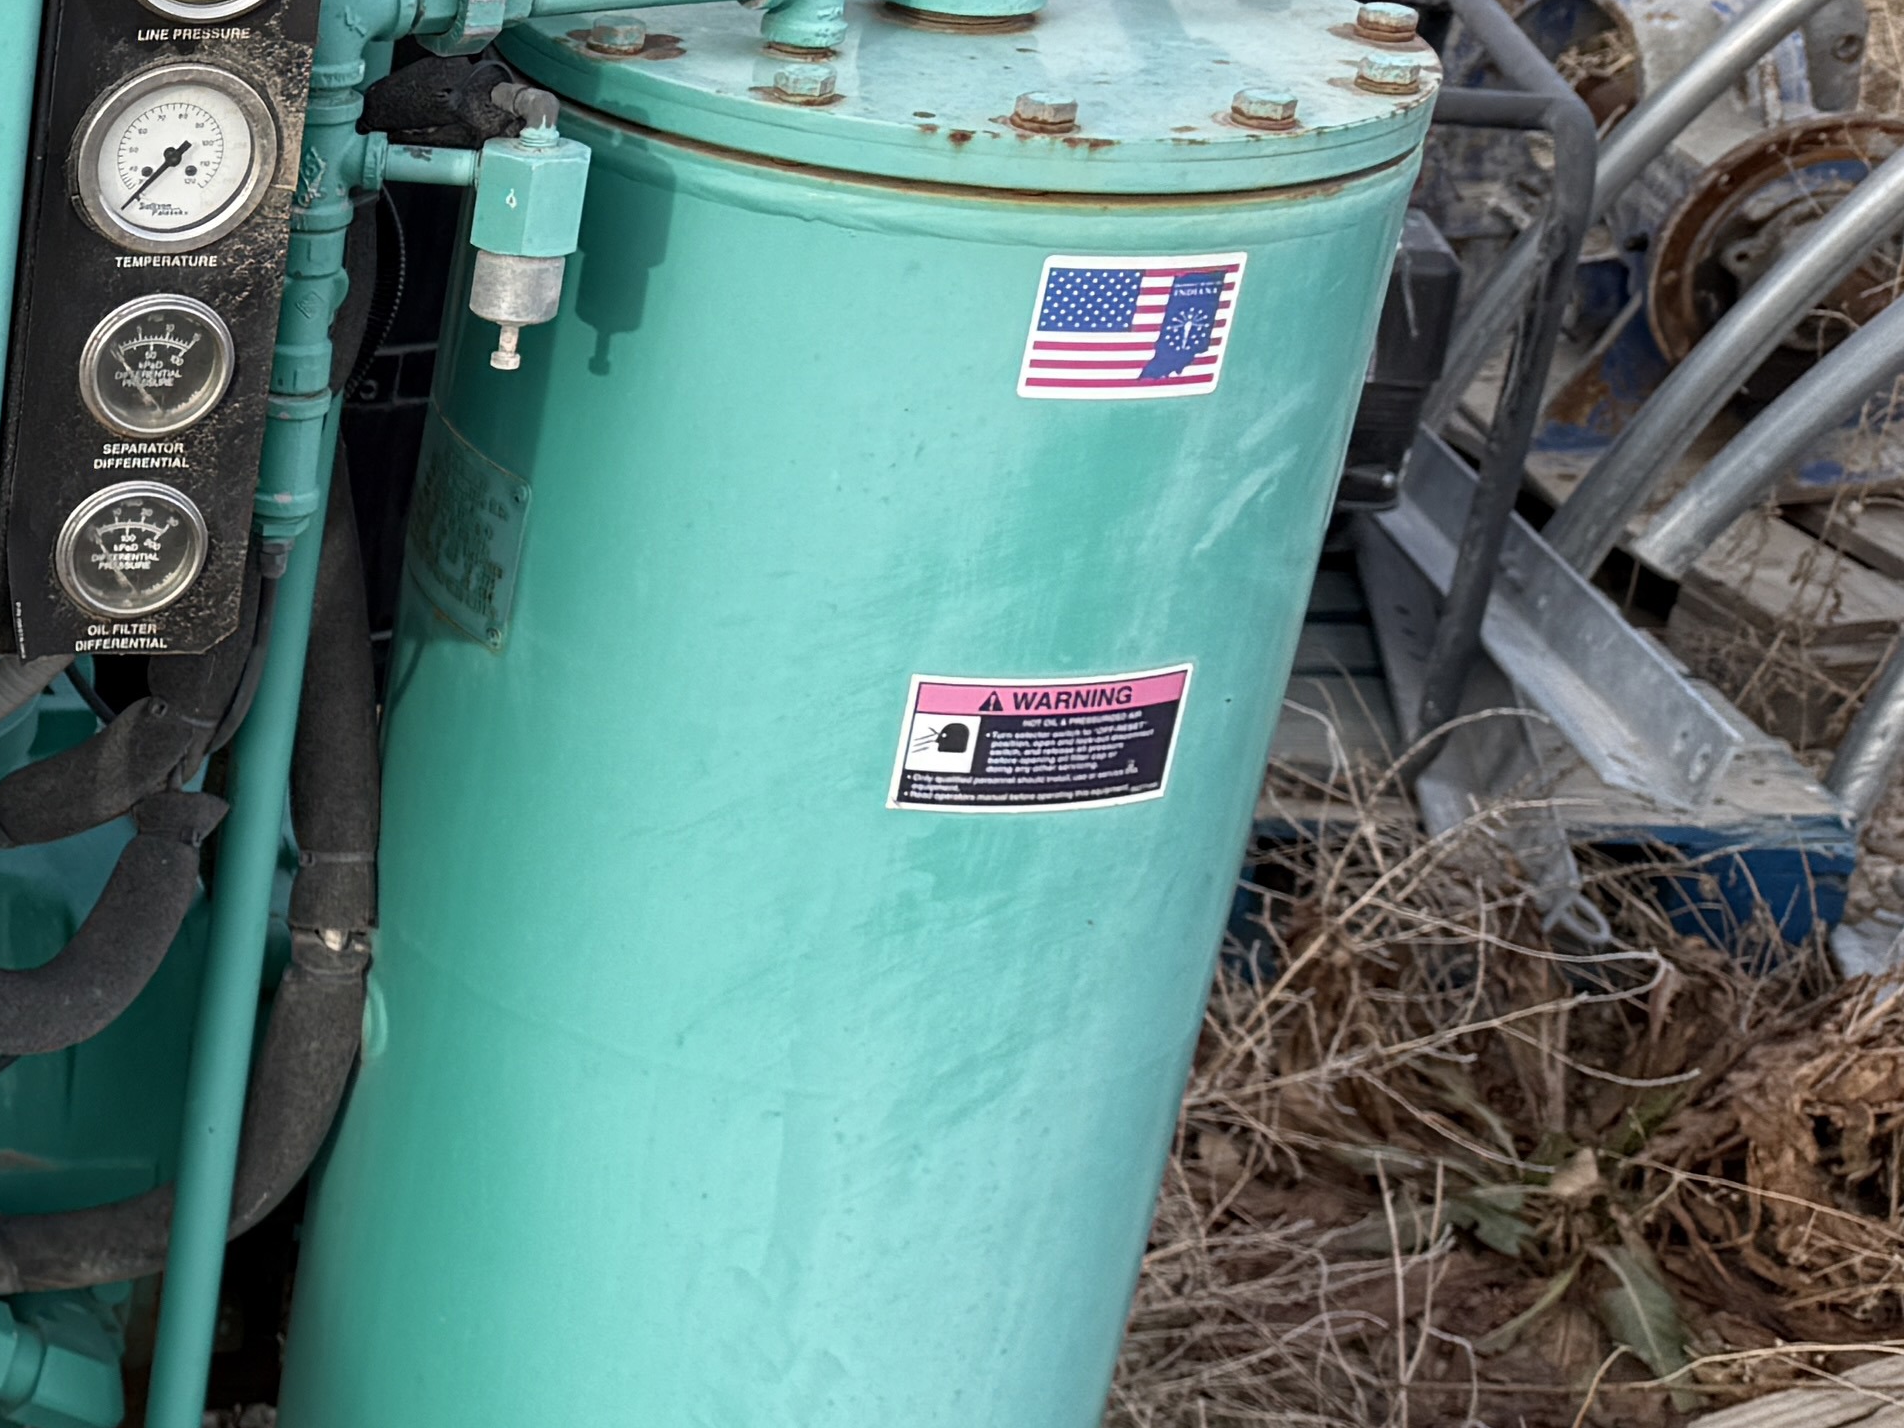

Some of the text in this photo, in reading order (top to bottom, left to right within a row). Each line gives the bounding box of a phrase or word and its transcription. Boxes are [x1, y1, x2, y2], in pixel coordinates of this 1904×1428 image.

[138, 27, 251, 41] LINE PRESSURE
[115, 256, 218, 267] TEMPERATURE
[103, 444, 184, 455] SEPARATOR
[94, 457, 189, 469] DIFFERENTIAL
[87, 624, 157, 636] OIL FILTER
[75, 638, 167, 651] DIFFERENTIAL
[1013, 686, 1132, 710] WARNING
